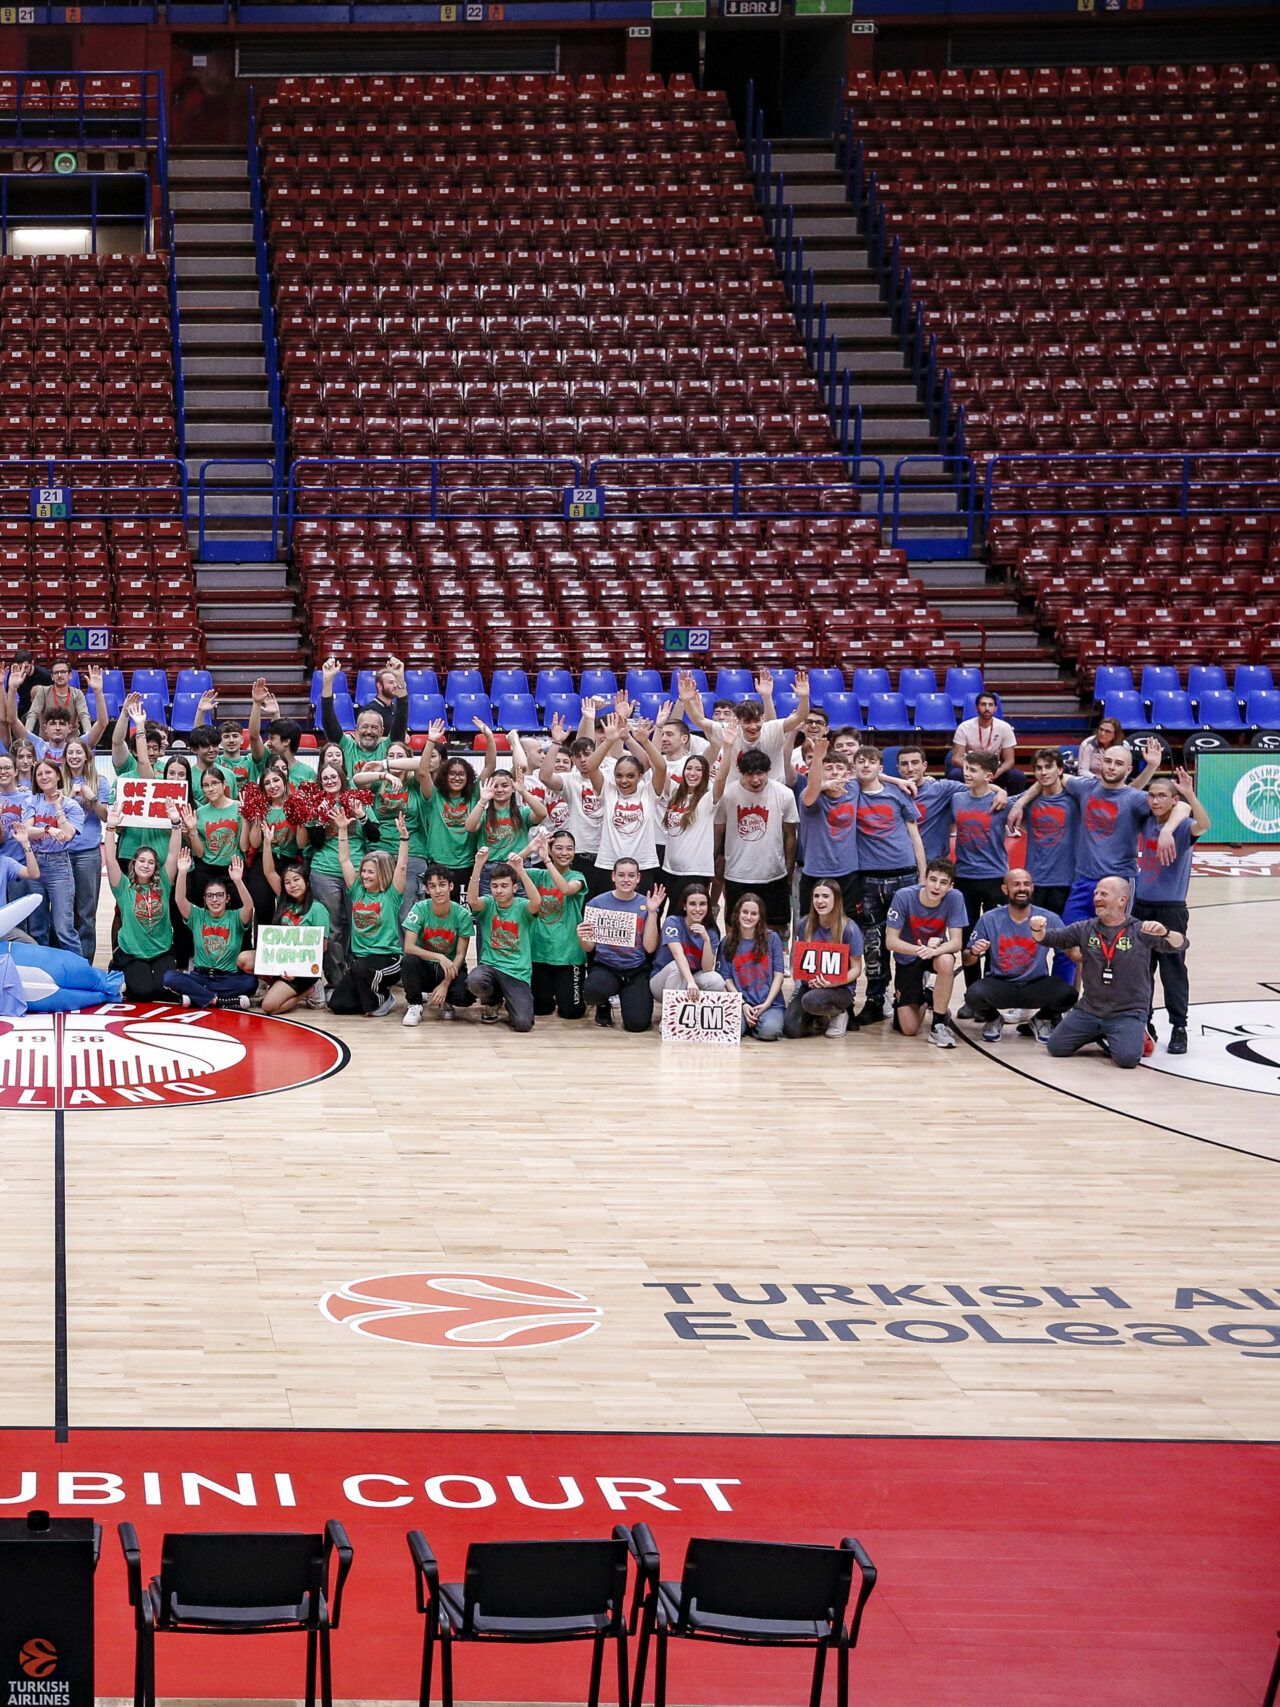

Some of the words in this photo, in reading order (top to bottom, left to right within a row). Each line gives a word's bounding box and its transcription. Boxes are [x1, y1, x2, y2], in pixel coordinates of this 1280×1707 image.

[468, 7, 482, 18] 22
[740, 2, 767, 13] BAR
[20, 10, 33, 21] 21
[43, 491, 58, 502] 21
[576, 490, 593, 501] 22
[69, 632, 83, 646] A
[90, 632, 107, 646] 21
[669, 633, 682, 647] A
[690, 633, 707, 646] 22
[597, 917, 620, 928] LICEO
[592, 928, 628, 939] ONATELLI
[642, 1282, 1132, 1311] TURKISH
[1172, 1288, 1280, 1312] AI
[340, 1473, 744, 1512] COURT
[8, 1681, 69, 1693] TURKISH
[7, 1694, 70, 1706] AIRLINES
